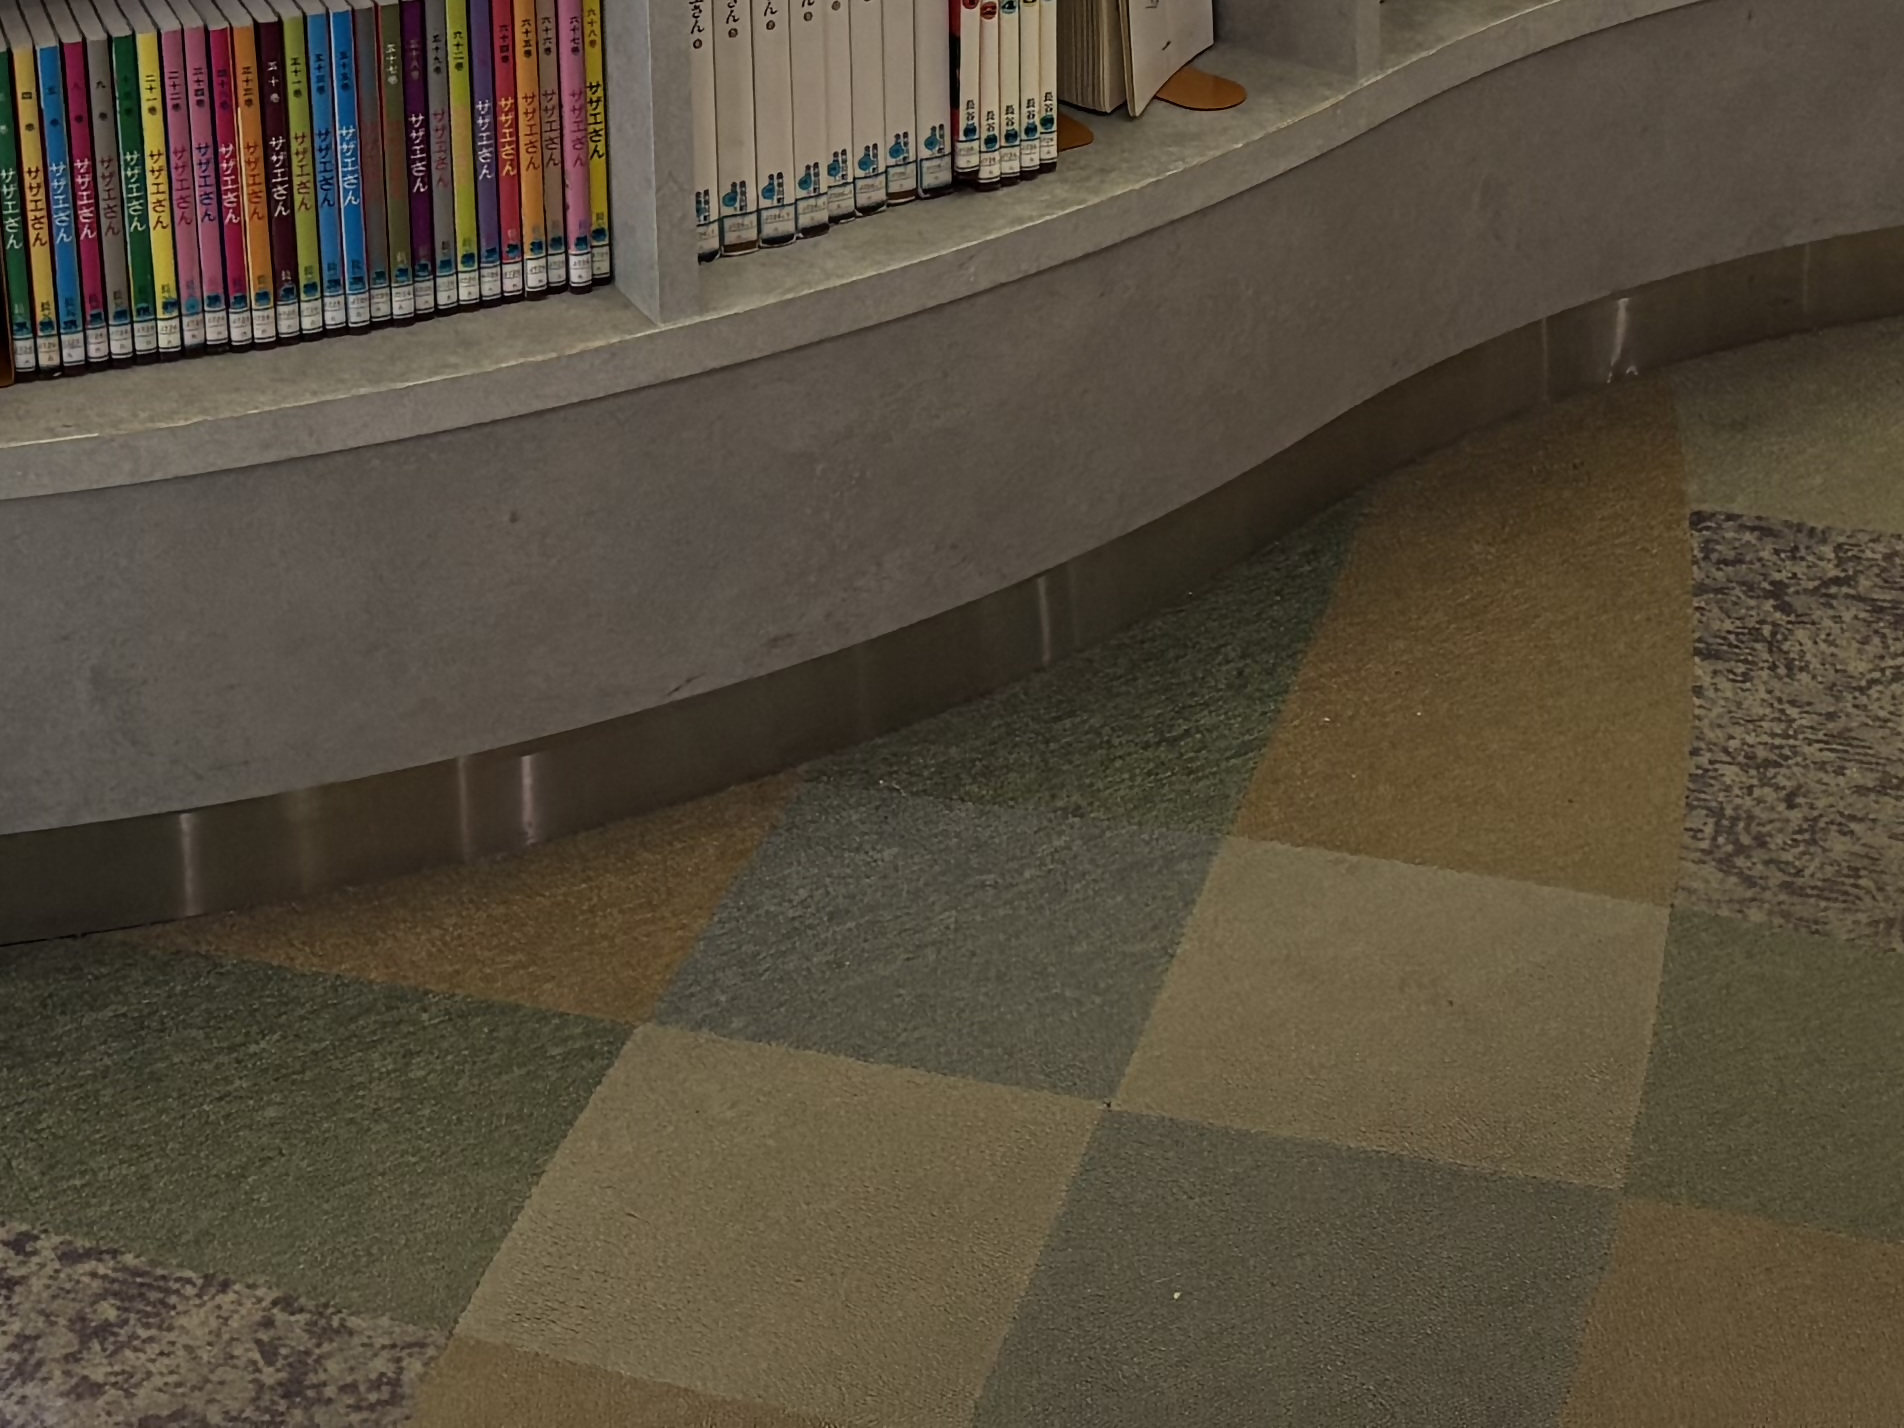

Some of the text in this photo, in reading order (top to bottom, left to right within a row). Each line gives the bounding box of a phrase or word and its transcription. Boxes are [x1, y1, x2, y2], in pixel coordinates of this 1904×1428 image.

[408, 113, 428, 193] サザエさん
[476, 99, 495, 179] サザエさん
[498, 96, 517, 177] サザエさん
[522, 92, 540, 171] サザエさん
[543, 88, 561, 167] サザエさん
[569, 88, 587, 167] サザエさん
[586, 81, 604, 160] サザエさん
[49, 161, 72, 244] サザエさん
[74, 158, 96, 240] サザエさん
[98, 154, 120, 237] サザエさん
[124, 150, 146, 233] サザエさん
[149, 148, 169, 231] サザエさん
[172, 145, 193, 227] サザエさん
[195, 142, 216, 223] サザエさん
[219, 141, 241, 225] サザエさん
[244, 140, 265, 221] サザエさん
[270, 135, 290, 217] サザエさん
[293, 131, 311, 211] サザエさん
[317, 127, 335, 208] サザエさん
[339, 124, 360, 206] サザエさん
[0, 169, 22, 250] サザエさん
[26, 166, 47, 247] サザエさん
